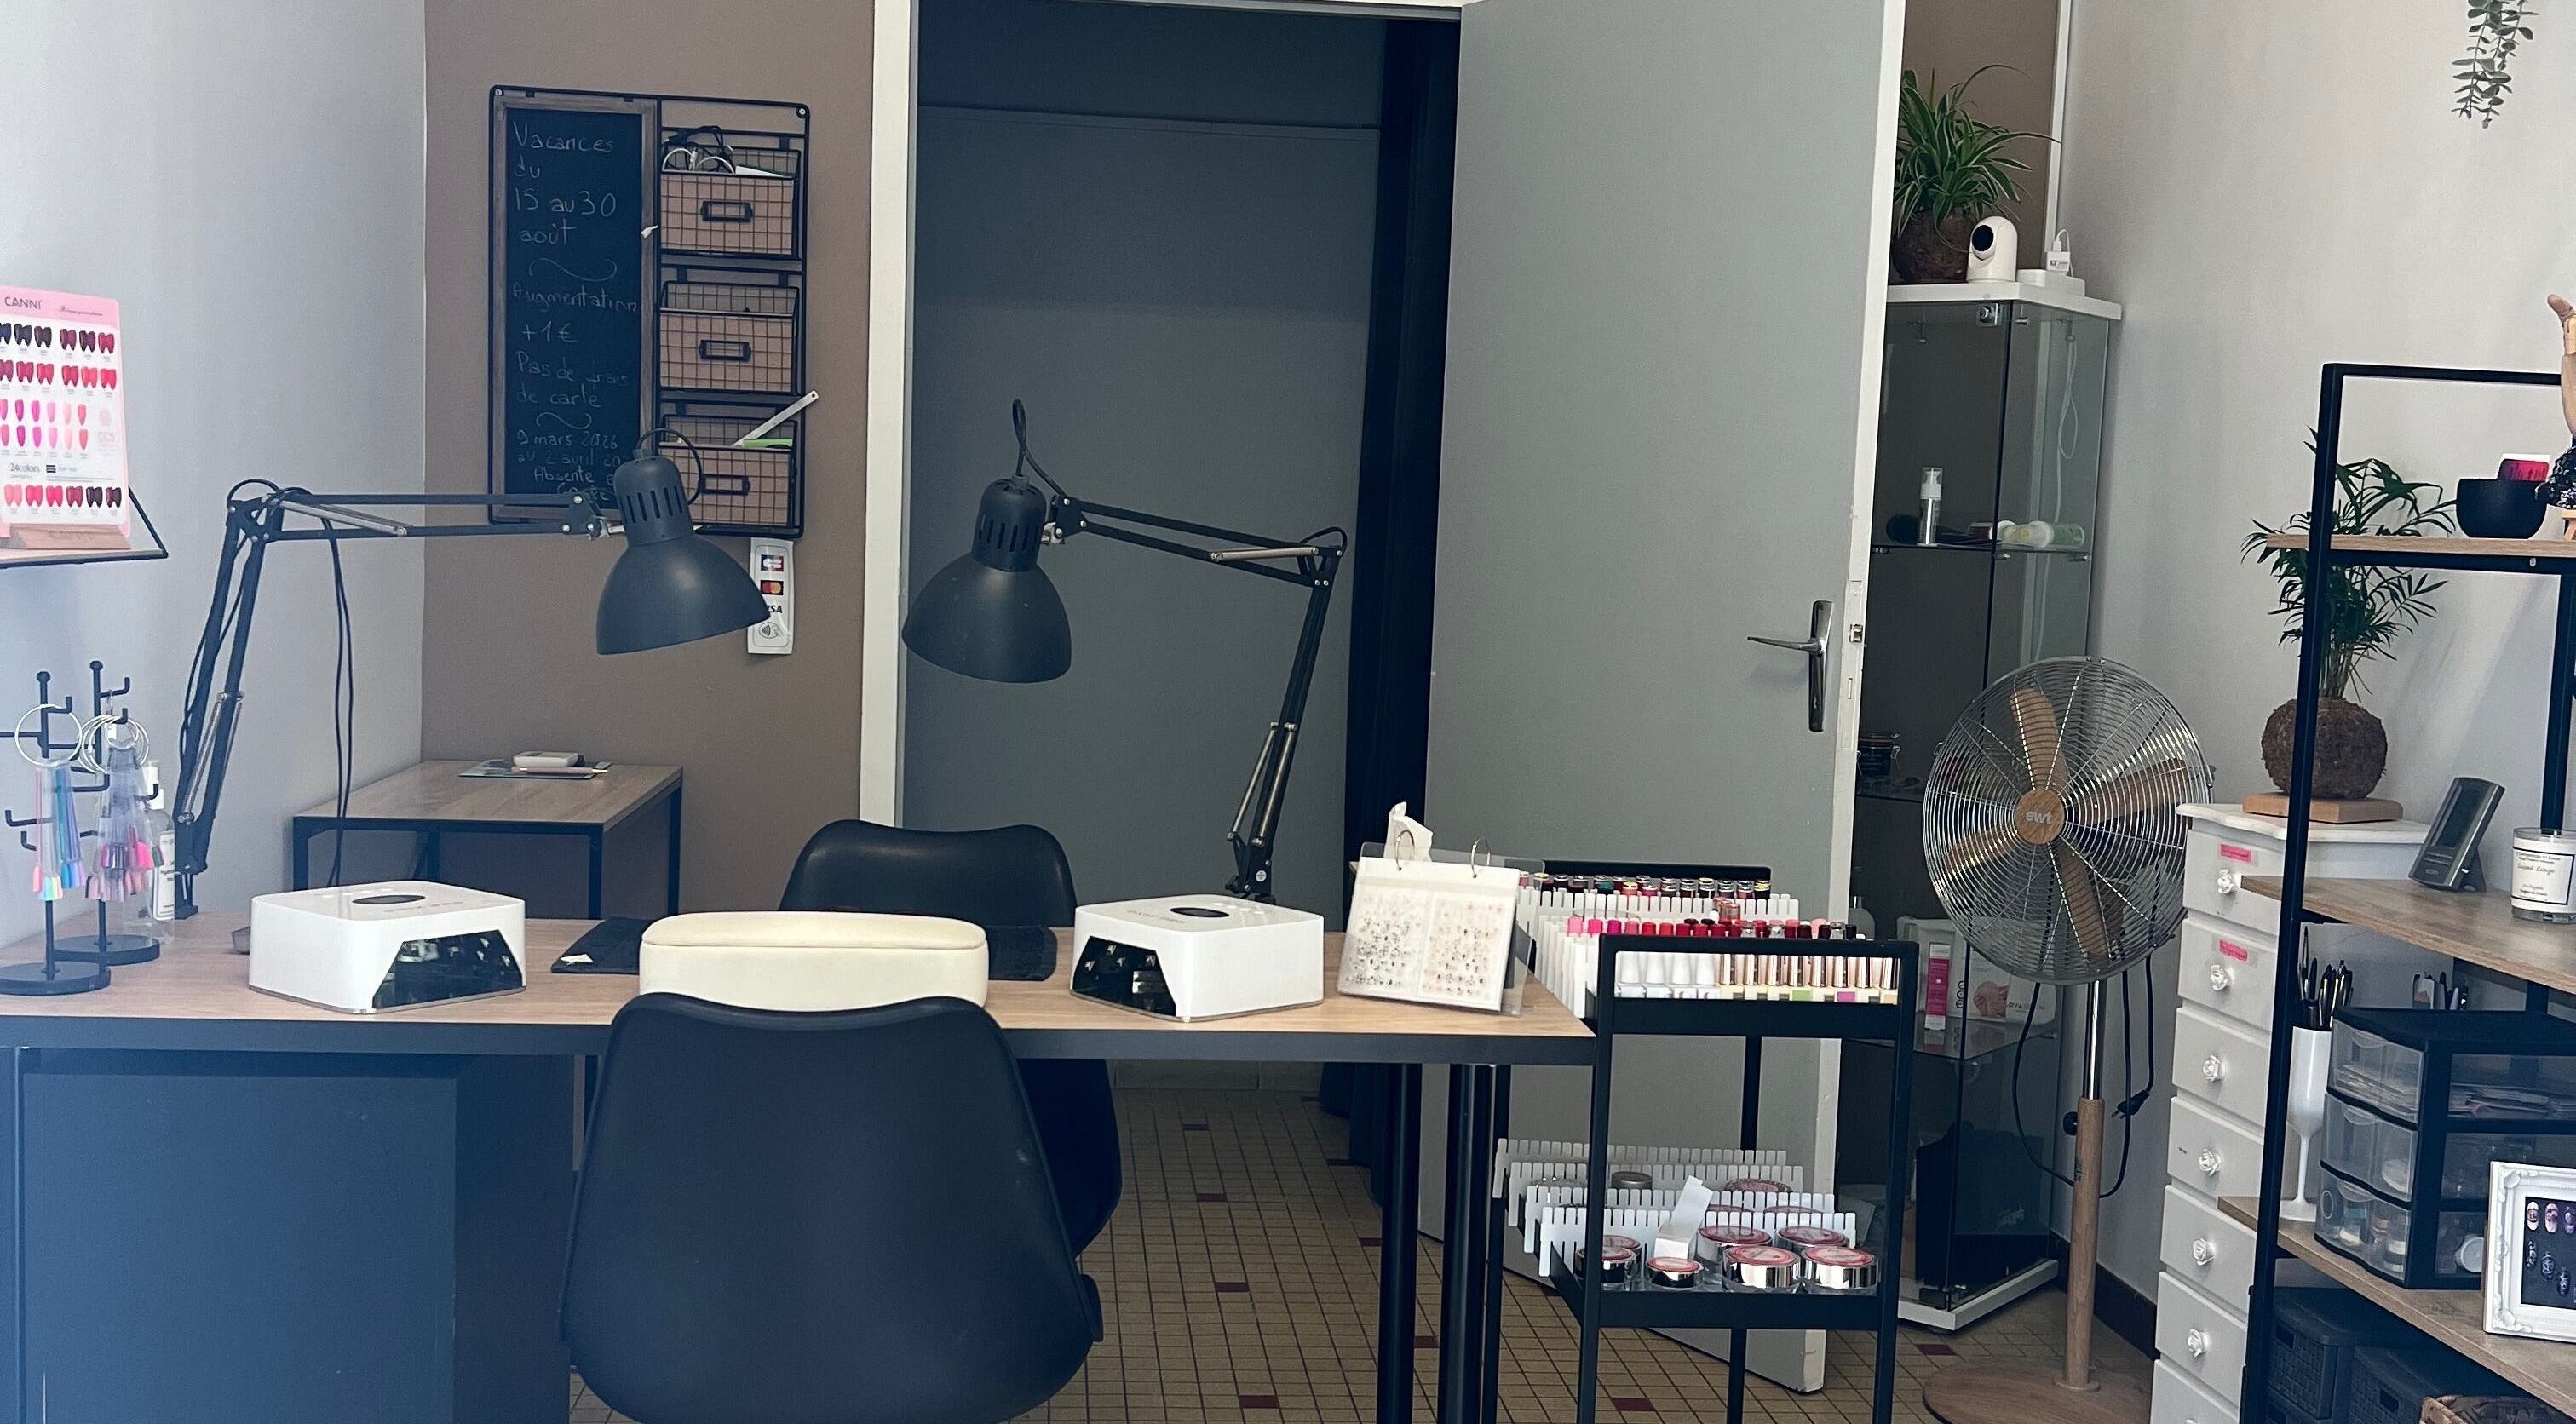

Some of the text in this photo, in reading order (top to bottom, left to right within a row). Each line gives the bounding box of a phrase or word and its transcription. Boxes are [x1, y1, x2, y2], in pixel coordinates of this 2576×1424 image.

[514, 122, 614, 152] Vacances
[514, 155, 541, 178] du
[515, 187, 616, 217] 15 au 30
[513, 282, 637, 313] Augmentation
[515, 350, 551, 376] Pas
[556, 356, 574, 382] de
[517, 382, 602, 408] de carte
[517, 429, 618, 449] 9 mars 2026
[560, 447, 595, 466] avril
[533, 464, 595, 483] Absente
[2026, 811, 2053, 824] ewt
